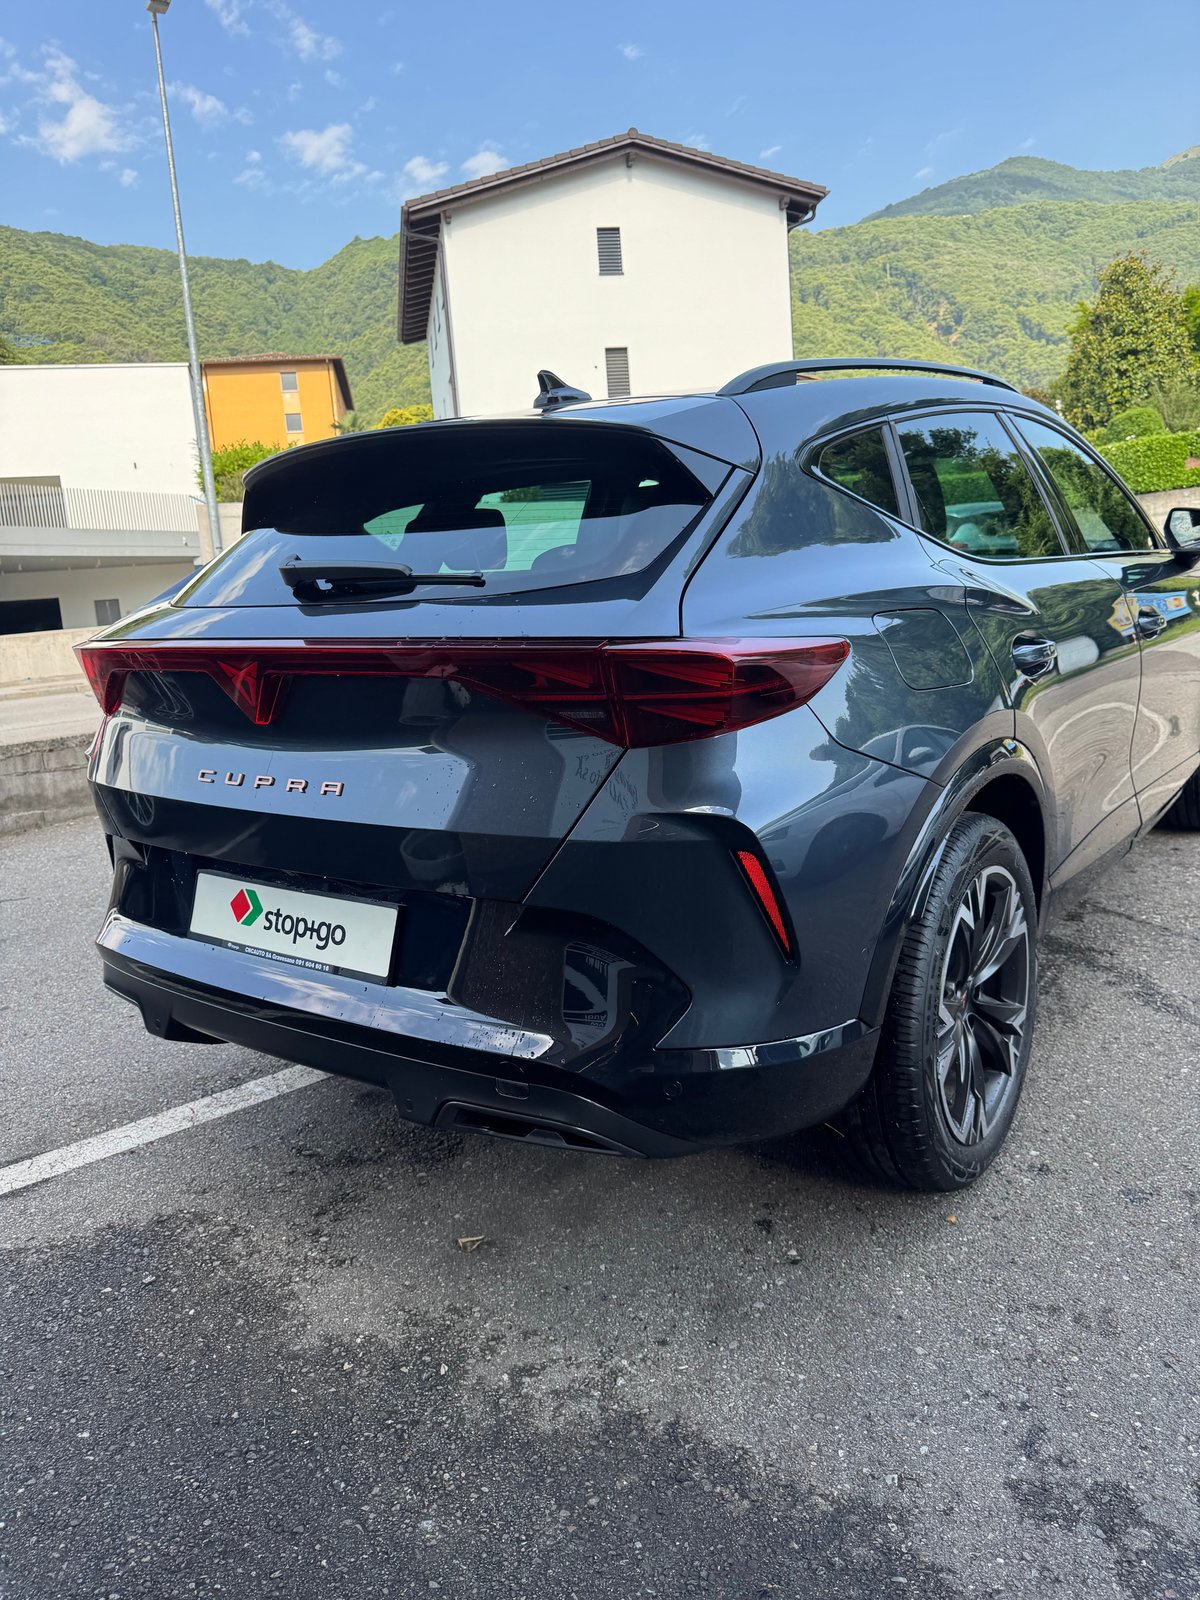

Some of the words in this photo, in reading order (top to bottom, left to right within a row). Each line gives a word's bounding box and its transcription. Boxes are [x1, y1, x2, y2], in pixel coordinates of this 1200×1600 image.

[197, 768, 345, 797] CUPRA
[263, 908, 347, 951] stop+go
[265, 951, 272, 959] SA
